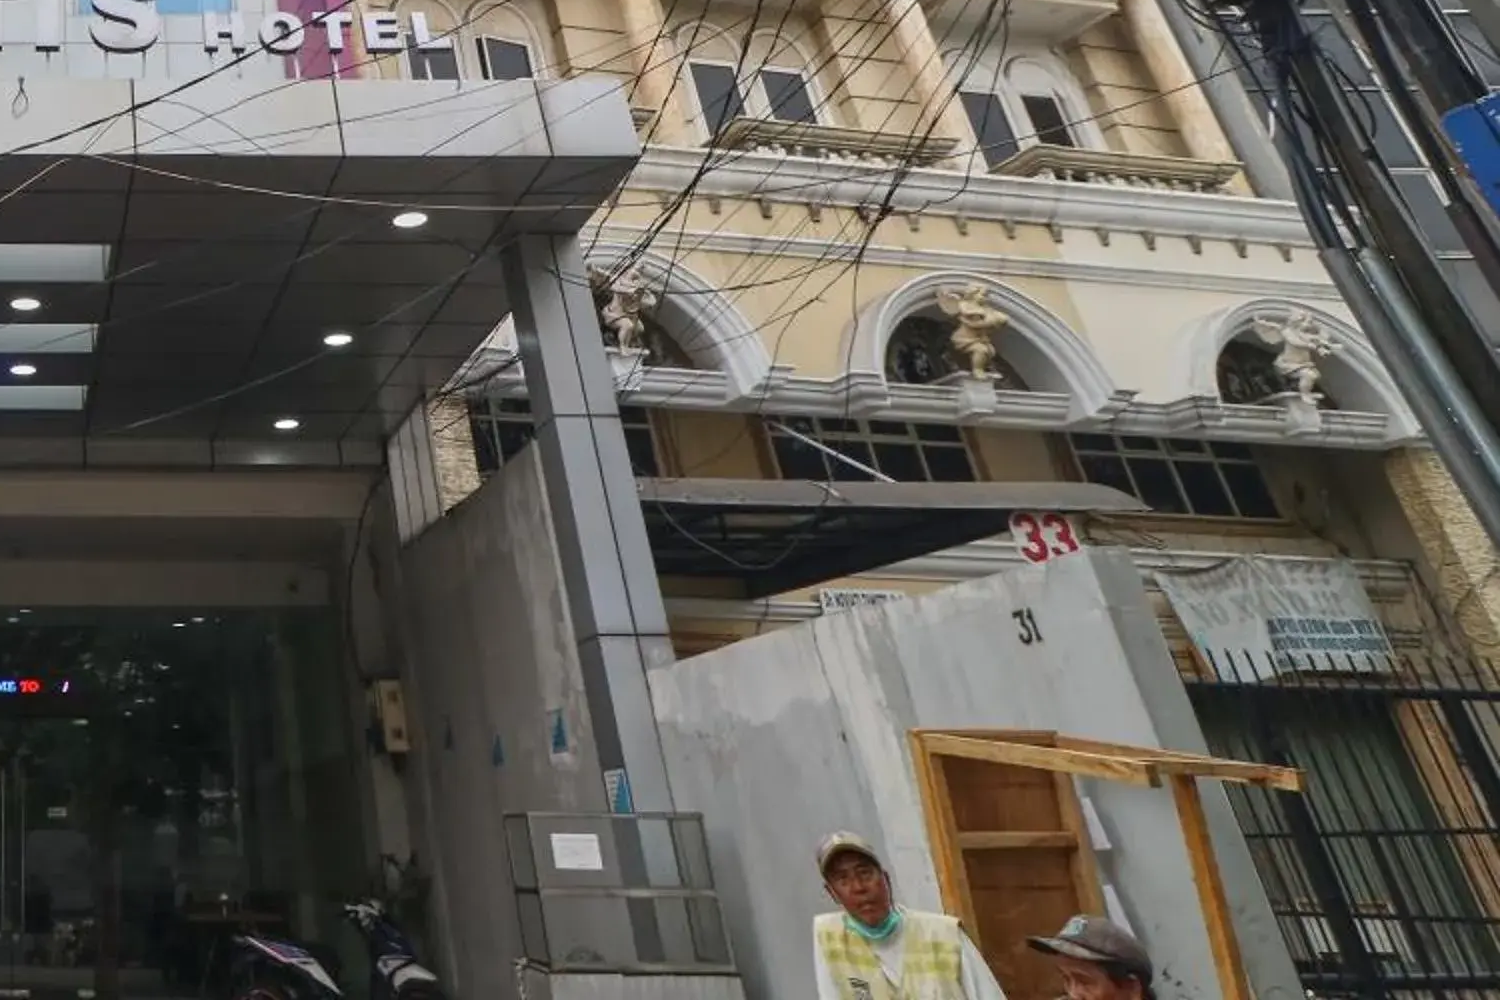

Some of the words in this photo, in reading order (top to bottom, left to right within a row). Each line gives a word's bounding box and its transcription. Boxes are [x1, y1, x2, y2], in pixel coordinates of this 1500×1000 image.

[204, 10, 456, 53] HOTEL
[1011, 512, 1079, 562] 33
[1011, 606, 1043, 645] 31
[19, 679, 40, 692] TO
